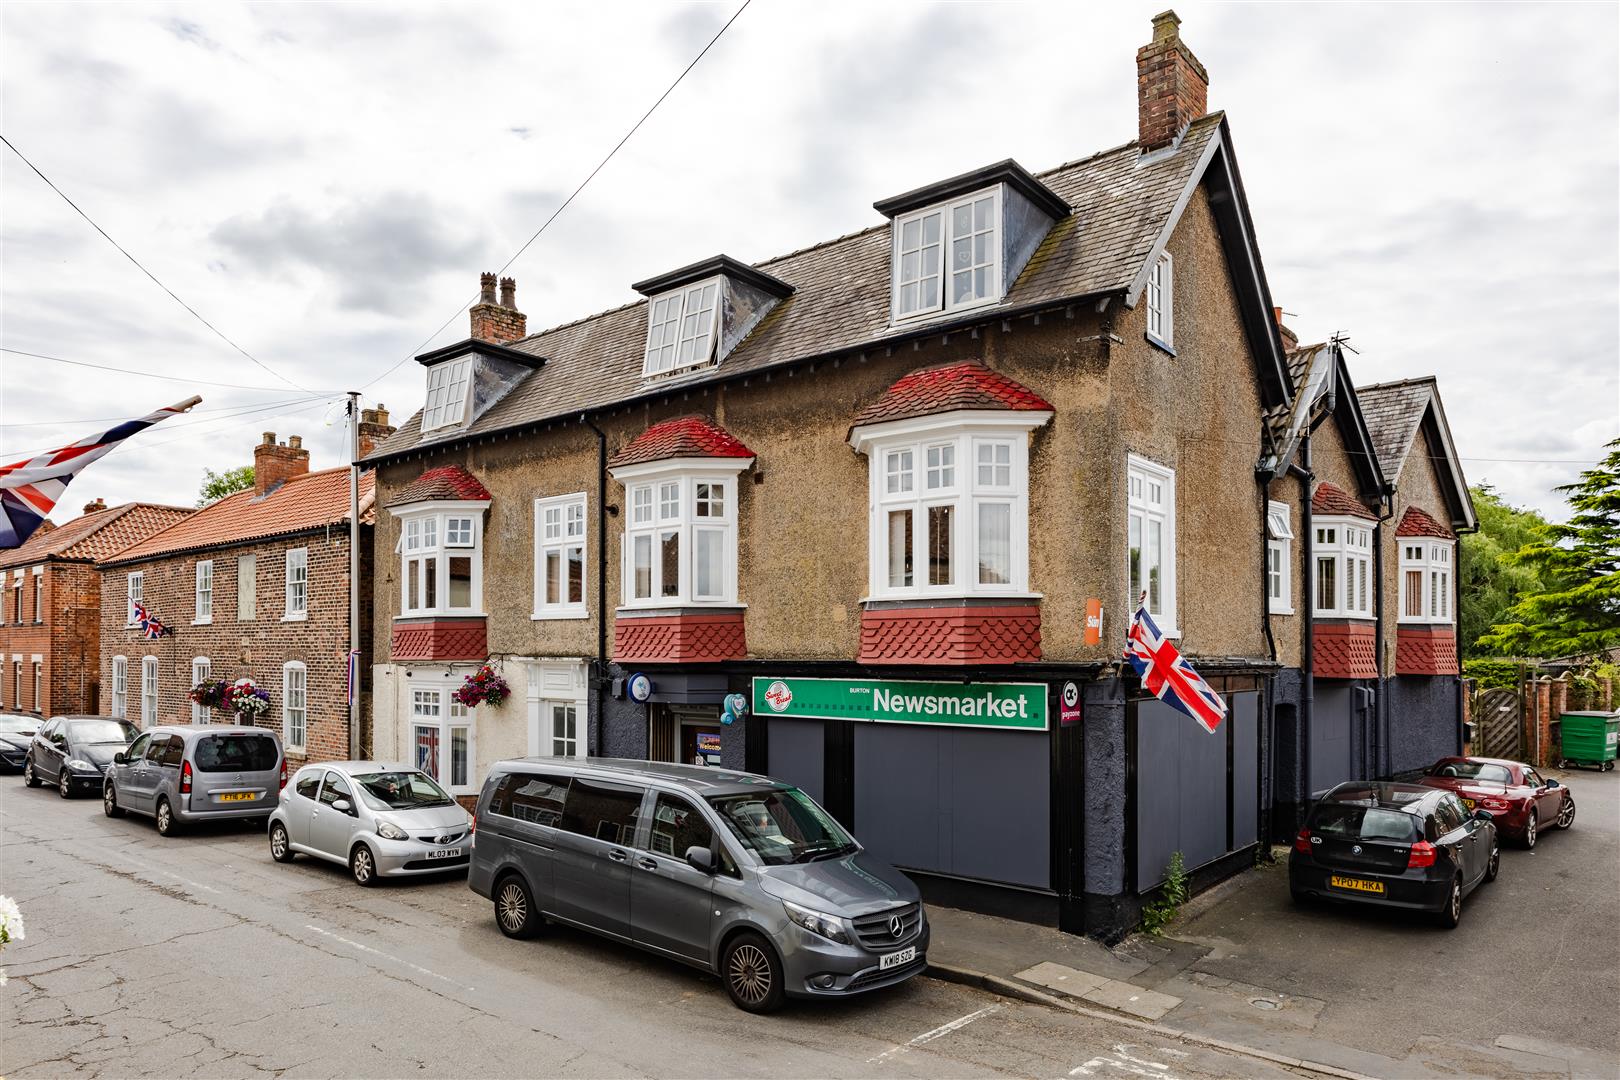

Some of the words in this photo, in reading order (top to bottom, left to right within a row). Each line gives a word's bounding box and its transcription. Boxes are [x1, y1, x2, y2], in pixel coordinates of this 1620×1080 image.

[765, 691, 782, 700] Sweet
[775, 692, 792, 705] Break
[873, 688, 1028, 719] Newsmarket
[1061, 710, 1080, 720] payzone
[428, 850, 446, 858] ML03
[1335, 877, 1360, 889] YP07
[1362, 880, 1381, 891] HKA
[884, 954, 900, 967] KM18
[900, 950, 912, 962] SZG
